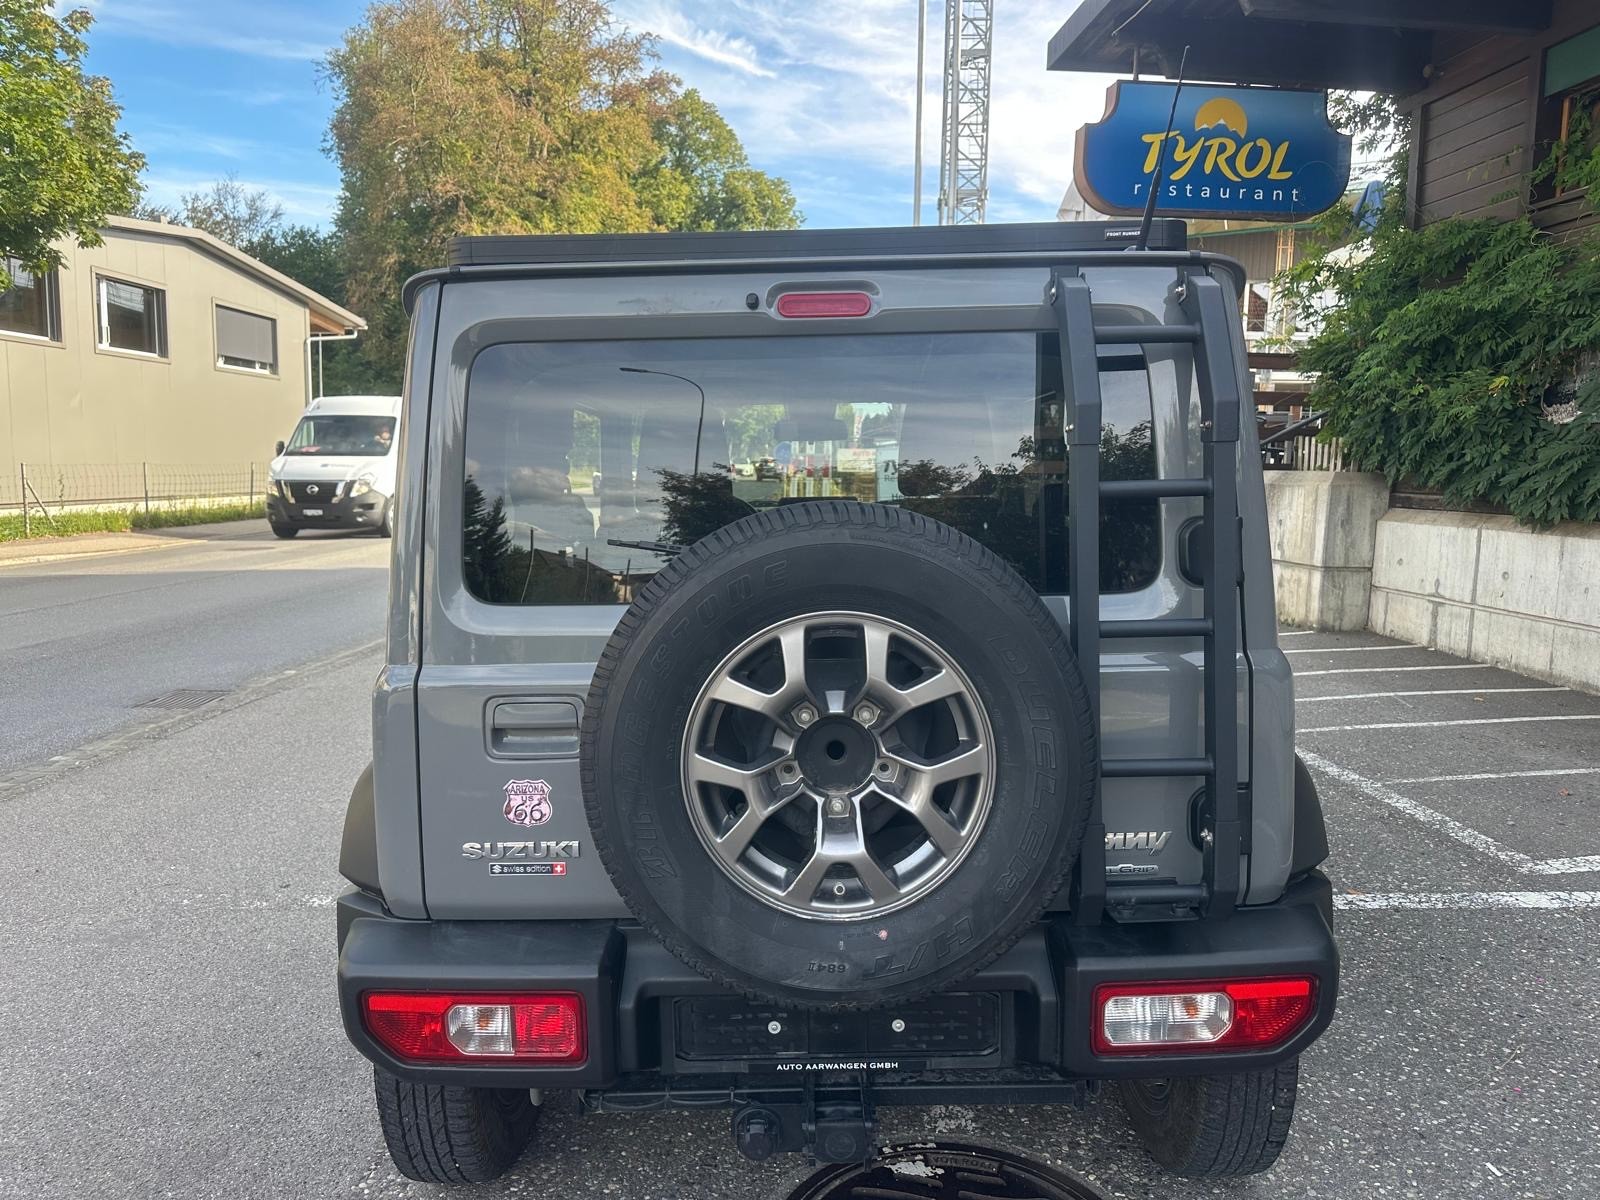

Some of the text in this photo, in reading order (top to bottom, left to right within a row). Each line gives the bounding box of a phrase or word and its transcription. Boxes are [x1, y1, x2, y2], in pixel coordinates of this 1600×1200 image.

[1140, 130, 1293, 182] TYROL
[1134, 183, 1299, 202] rstaurant
[509, 784, 545, 794] ARIZONA
[514, 803, 545, 822] 66
[462, 840, 580, 859] SUZUKI
[526, 865, 551, 873] edition
